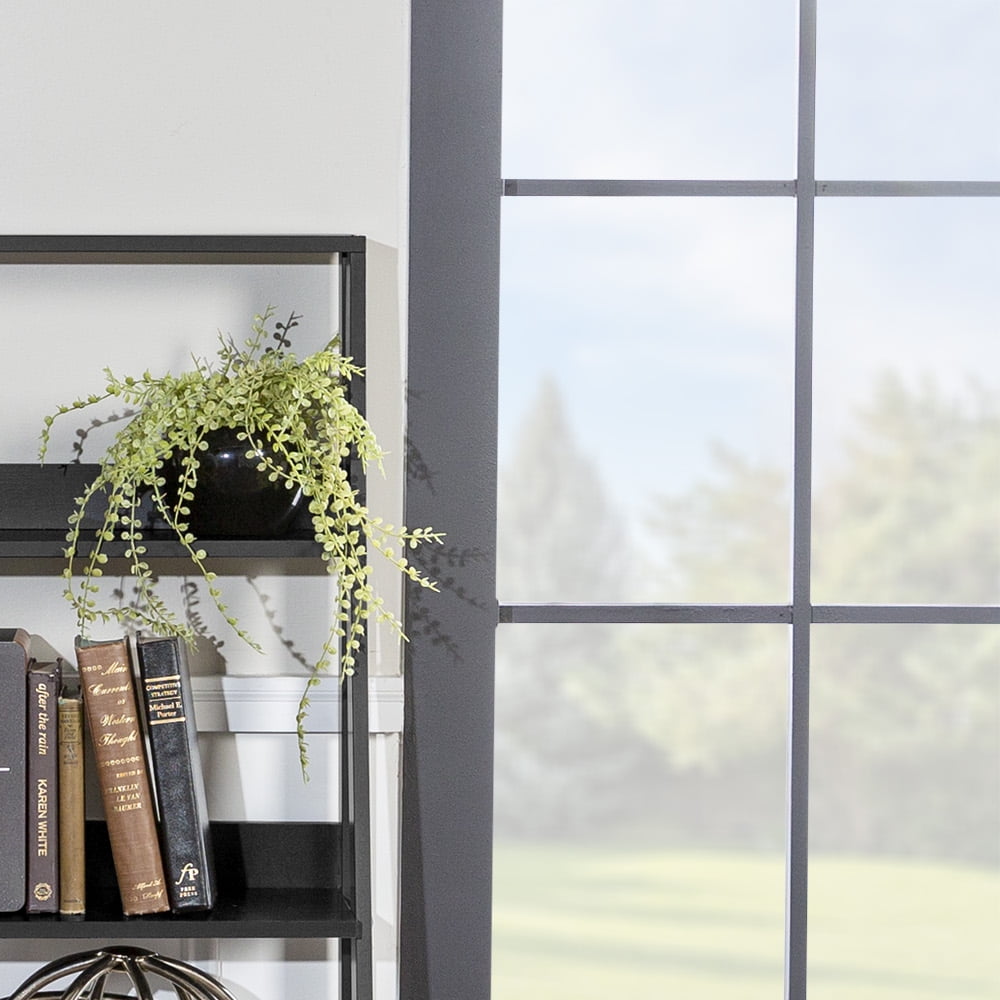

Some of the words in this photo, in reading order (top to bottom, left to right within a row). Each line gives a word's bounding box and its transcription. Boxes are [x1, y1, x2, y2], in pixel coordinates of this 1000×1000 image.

[36, 683, 50, 710] after
[149, 701, 175, 712] Michael
[38, 713, 50, 731] the
[100, 713, 136, 727] Western
[38, 732, 49, 756] rain
[98, 730, 138, 747] Thought
[107, 783, 140, 795] RANKLIN
[37, 779, 48, 818] KAREN
[37, 820, 48, 857] WHITE
